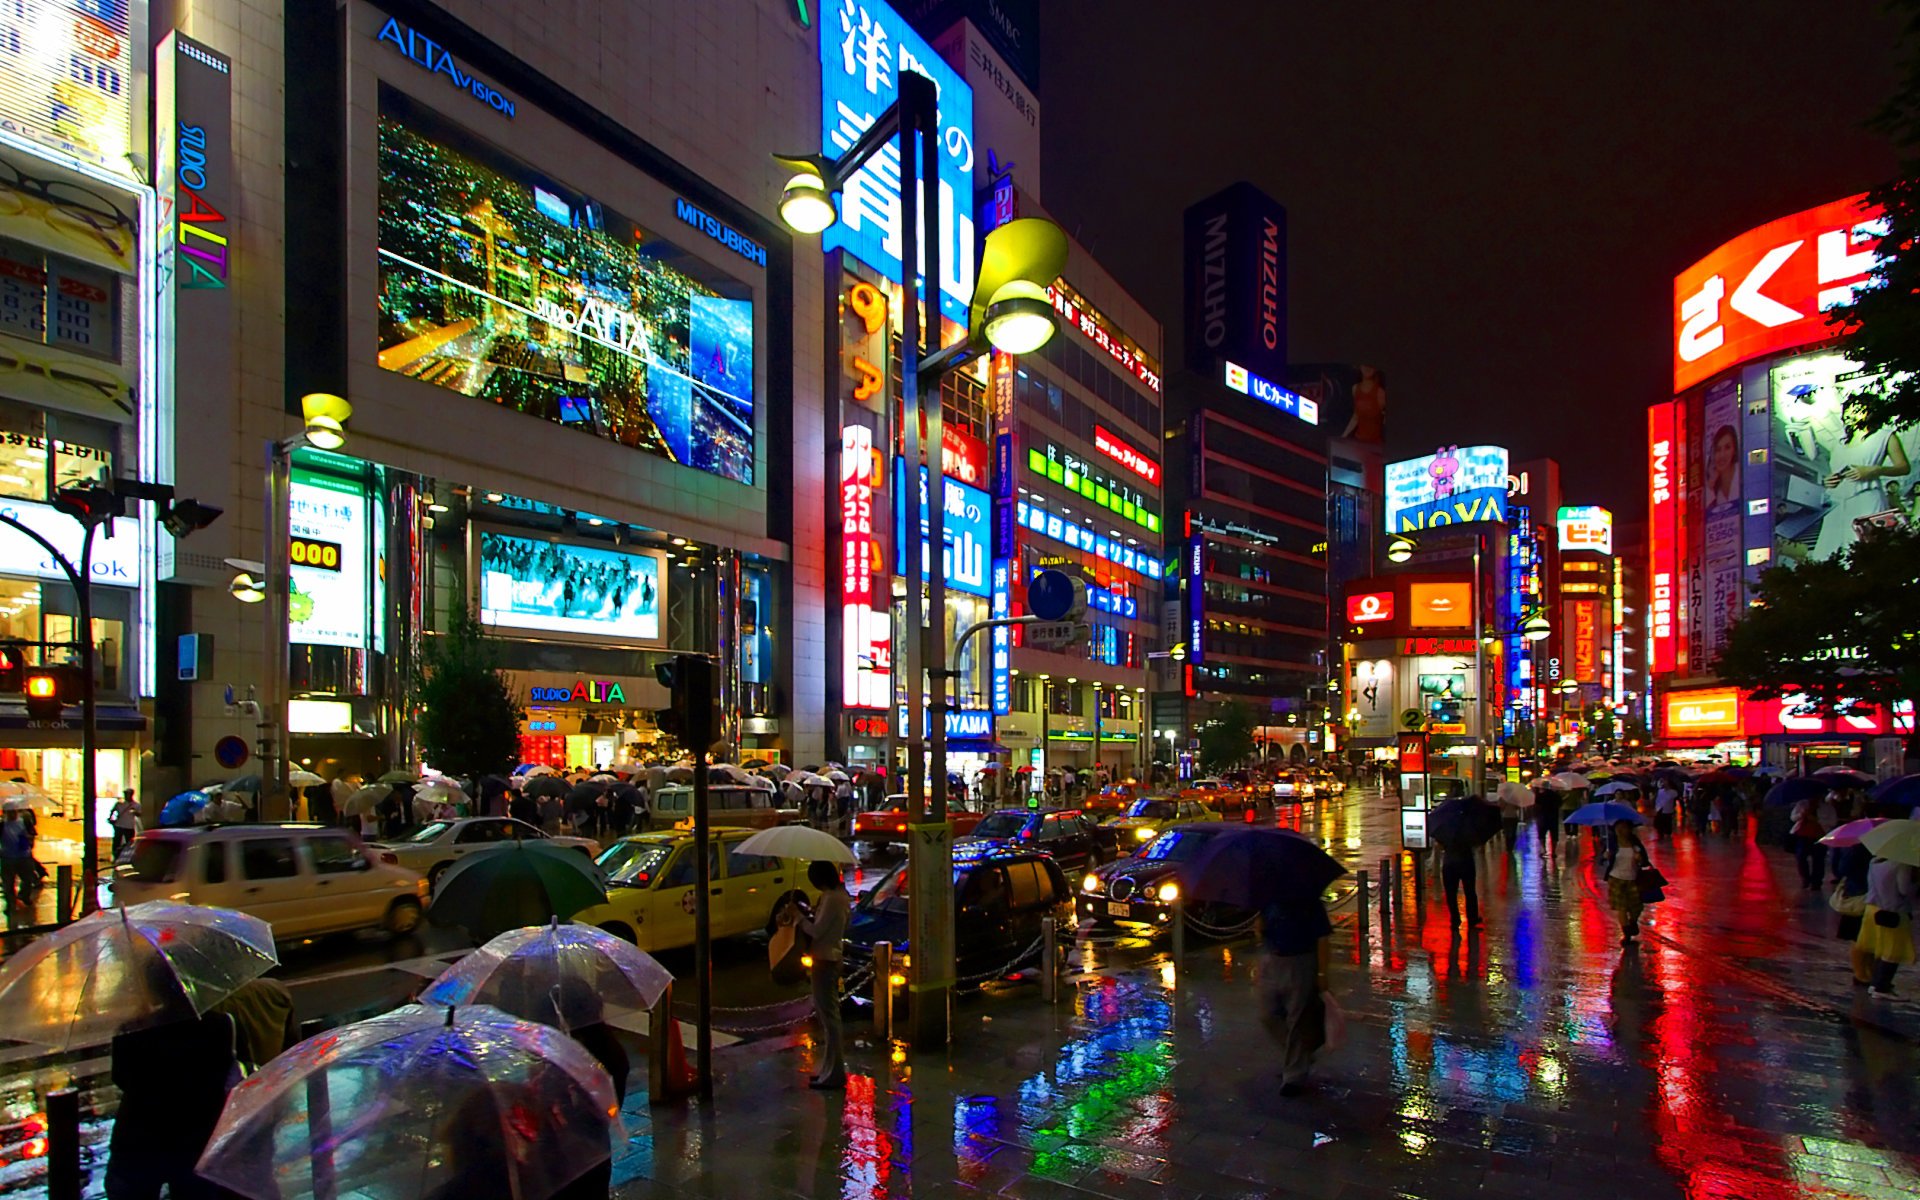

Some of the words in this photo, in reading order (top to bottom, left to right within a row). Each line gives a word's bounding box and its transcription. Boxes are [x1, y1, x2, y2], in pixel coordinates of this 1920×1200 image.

[970, 40, 1036, 127] 三井住友銀行
[179, 121, 206, 190] STUDIO
[179, 184, 227, 289] ALTA
[676, 198, 767, 268] MITSUBISHI
[1205, 213, 1227, 347] MIZUHO
[1263, 216, 1278, 350] MIZUHO
[576, 299, 655, 360] ALTA
[1402, 496, 1503, 533] NOVA
[531, 687, 571, 702] STUDIO
[570, 680, 625, 703] ALTA
[1405, 711, 1420, 727] 2
